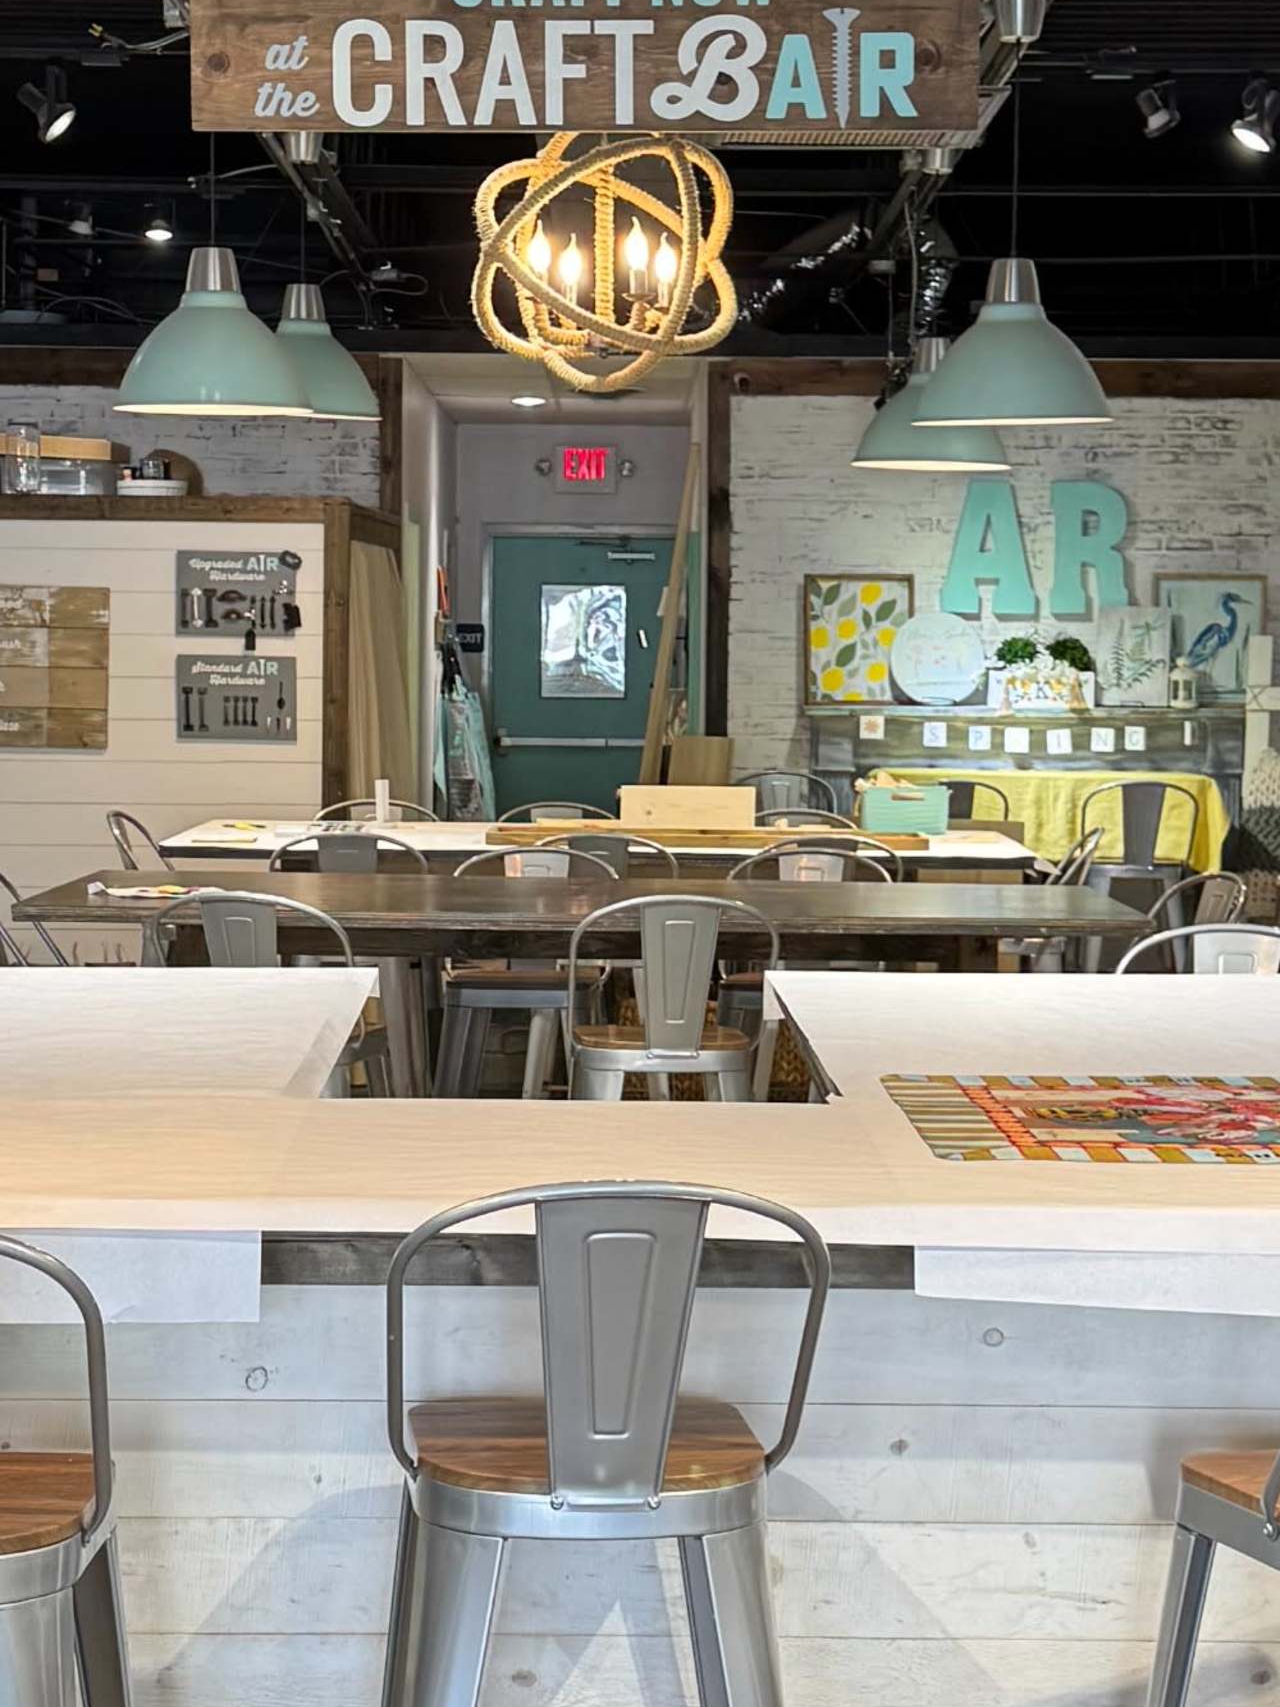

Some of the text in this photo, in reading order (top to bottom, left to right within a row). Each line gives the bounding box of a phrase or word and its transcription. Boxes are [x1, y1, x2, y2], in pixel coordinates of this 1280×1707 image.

[265, 34, 310, 72] at
[332, 17, 656, 128] CRAFT
[254, 82, 320, 120] the
[564, 447, 608, 481] EXIT
[940, 478, 1129, 615] AR
[191, 661, 243, 674] Standard
[209, 674, 266, 685] Hardware
